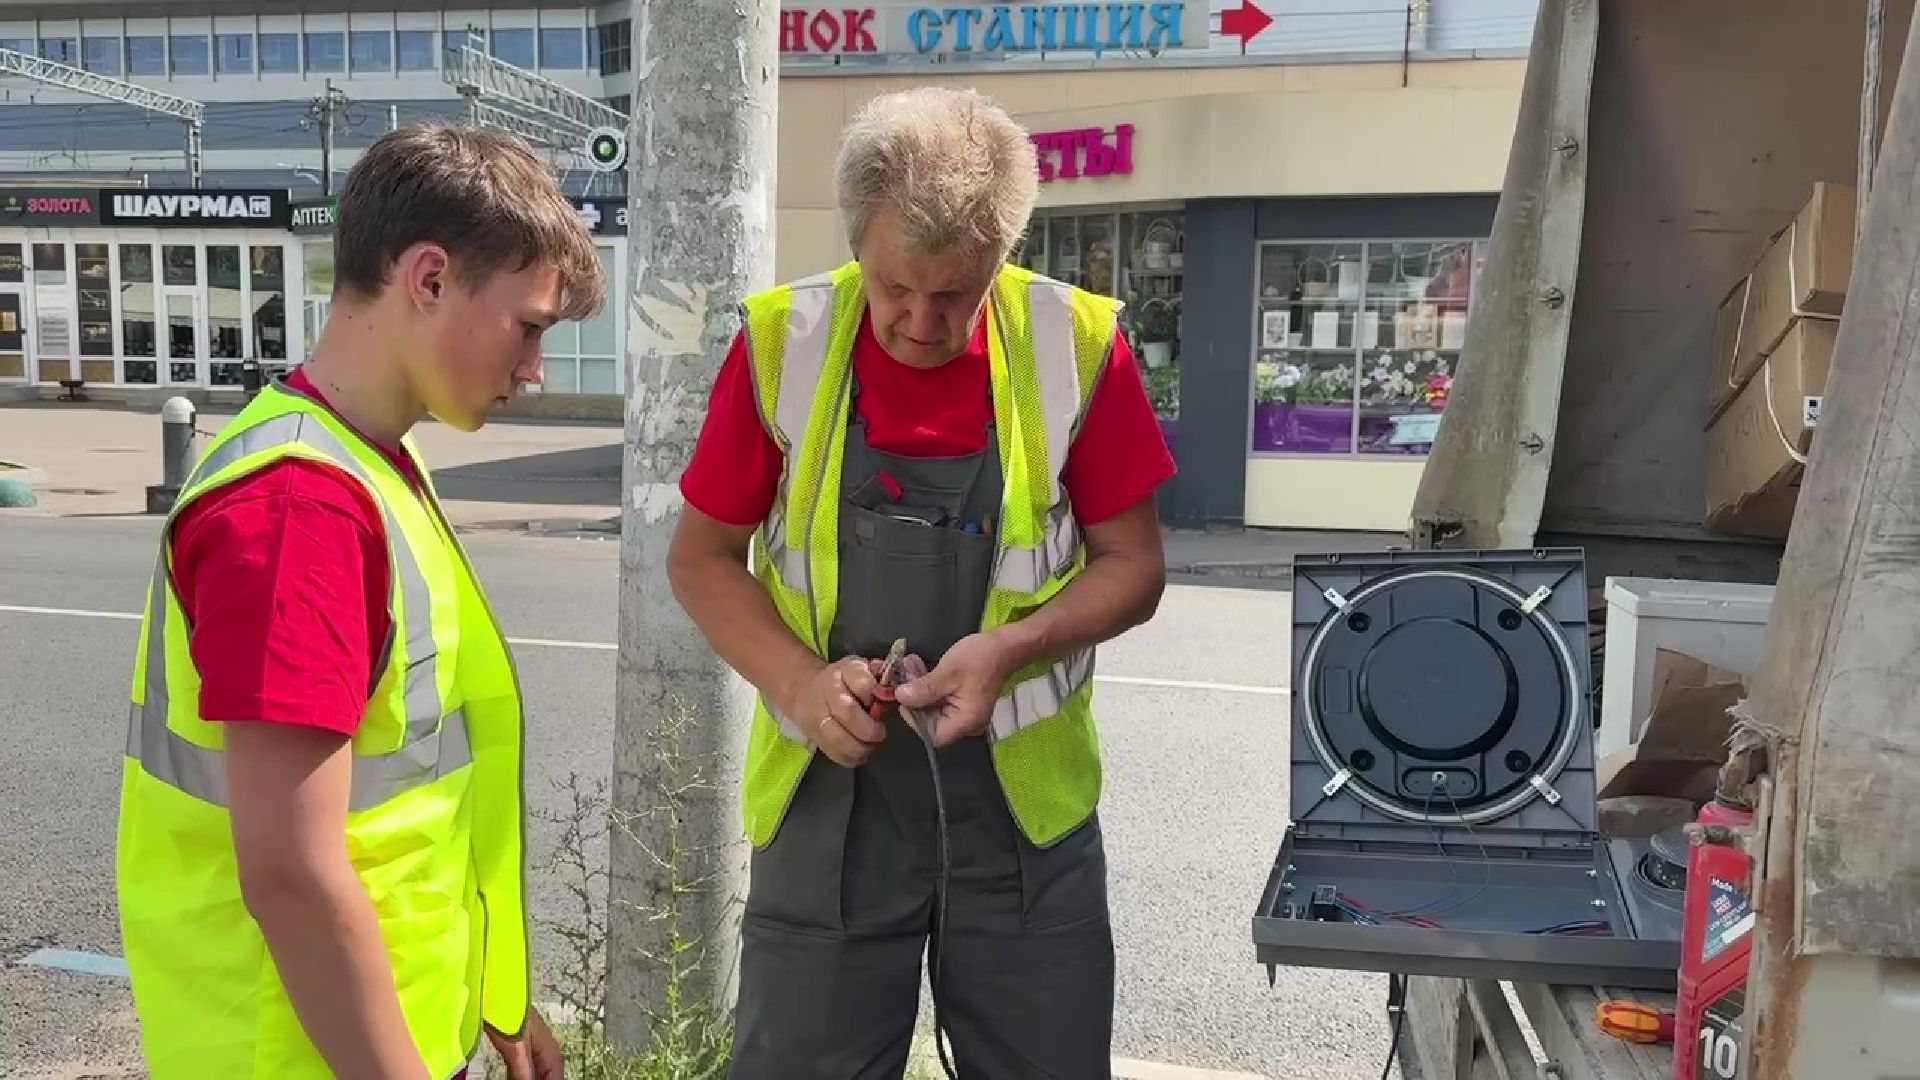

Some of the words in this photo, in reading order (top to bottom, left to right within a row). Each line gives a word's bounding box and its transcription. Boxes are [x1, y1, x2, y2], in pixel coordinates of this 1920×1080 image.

[908, 3, 1183, 57] СТАНЦИЯ
[27, 198, 91, 213] ЗОЛОТА
[113, 195, 249, 217] ШАУРМА
[1699, 1026, 1736, 1079] 10
